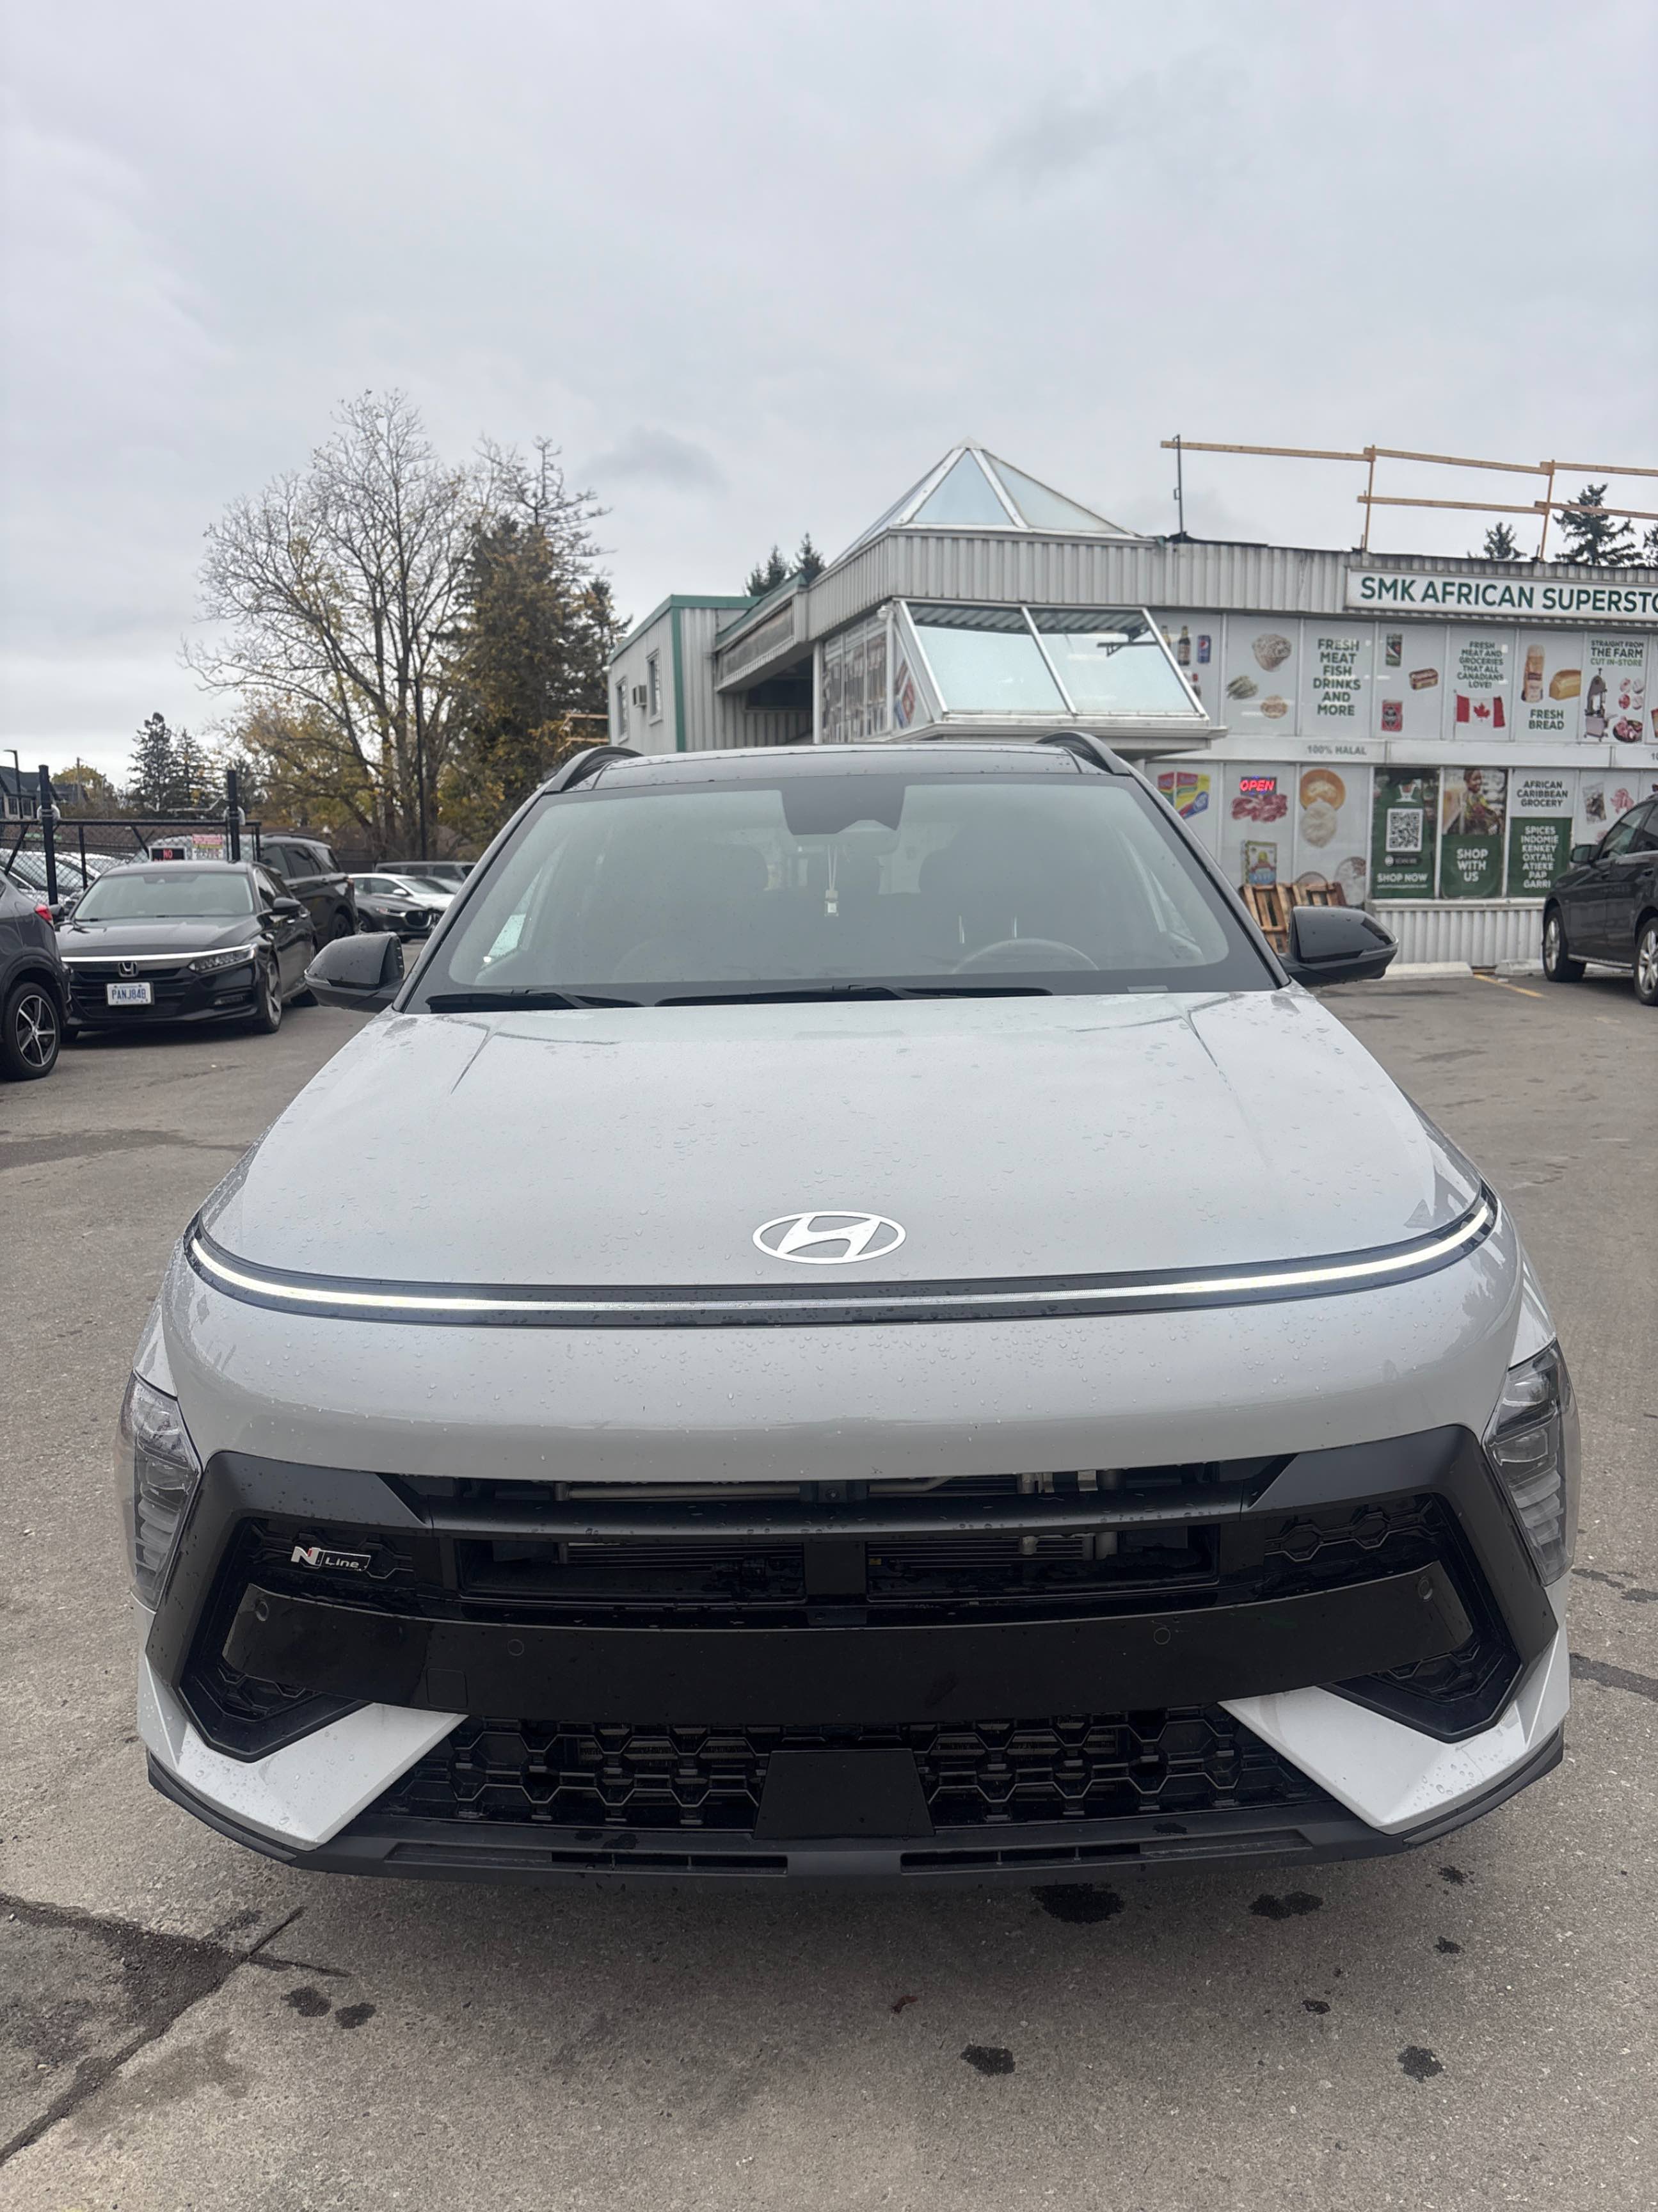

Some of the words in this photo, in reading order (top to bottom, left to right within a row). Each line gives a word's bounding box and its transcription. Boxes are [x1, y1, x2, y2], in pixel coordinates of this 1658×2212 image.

[1360, 576, 1416, 602] SMK
[1421, 580, 1534, 609] AFRICAN
[1542, 587, 1658, 613] SUPERST
[1318, 638, 1360, 651] FRESH
[1469, 641, 1495, 649] FRESH
[1319, 652, 1357, 664] MEAT
[1591, 647, 1611, 657] THE
[1613, 648, 1643, 658] FARM
[1459, 656, 1504, 666] GROCERIES
[1606, 659, 1643, 667] IN-STORE
[1323, 665, 1352, 676] FISH
[1457, 671, 1504, 681] CANADIANS
[1313, 677, 1361, 691] DRINKS
[1321, 691, 1351, 702] AND
[1317, 704, 1355, 716] MORE
[1530, 708, 1564, 719] FRESH
[1528, 719, 1565, 730] BREAD
[1307, 744, 1332, 755] 100%
[1335, 746, 1367, 756] HALAL
[1240, 780, 1275, 792] OPEN
[1523, 780, 1563, 789] AFRICAN
[1517, 789, 1568, 799] CARIBBEAN
[1520, 798, 1563, 808] GROCERY
[1525, 826, 1556, 835] SPICES
[1520, 835, 1559, 844] INDOMIE
[163, 849, 173, 859] NO
[1456, 848, 1489, 860] SHOP
[1522, 844, 1557, 853] KENKEY
[1522, 853, 1555, 862] OXTAIL
[1456, 860, 1487, 871] WITH
[1522, 862, 1554, 870] ATIEKE
[1377, 872, 1403, 883] SHOP
[1404, 872, 1428, 883] NOW
[1463, 871, 1479, 883] US
[1528, 870, 1547, 879] PAP
[1523, 879, 1551, 888] GARRI
[291, 1546, 321, 1566] N
[324, 1556, 360, 1569] Line
